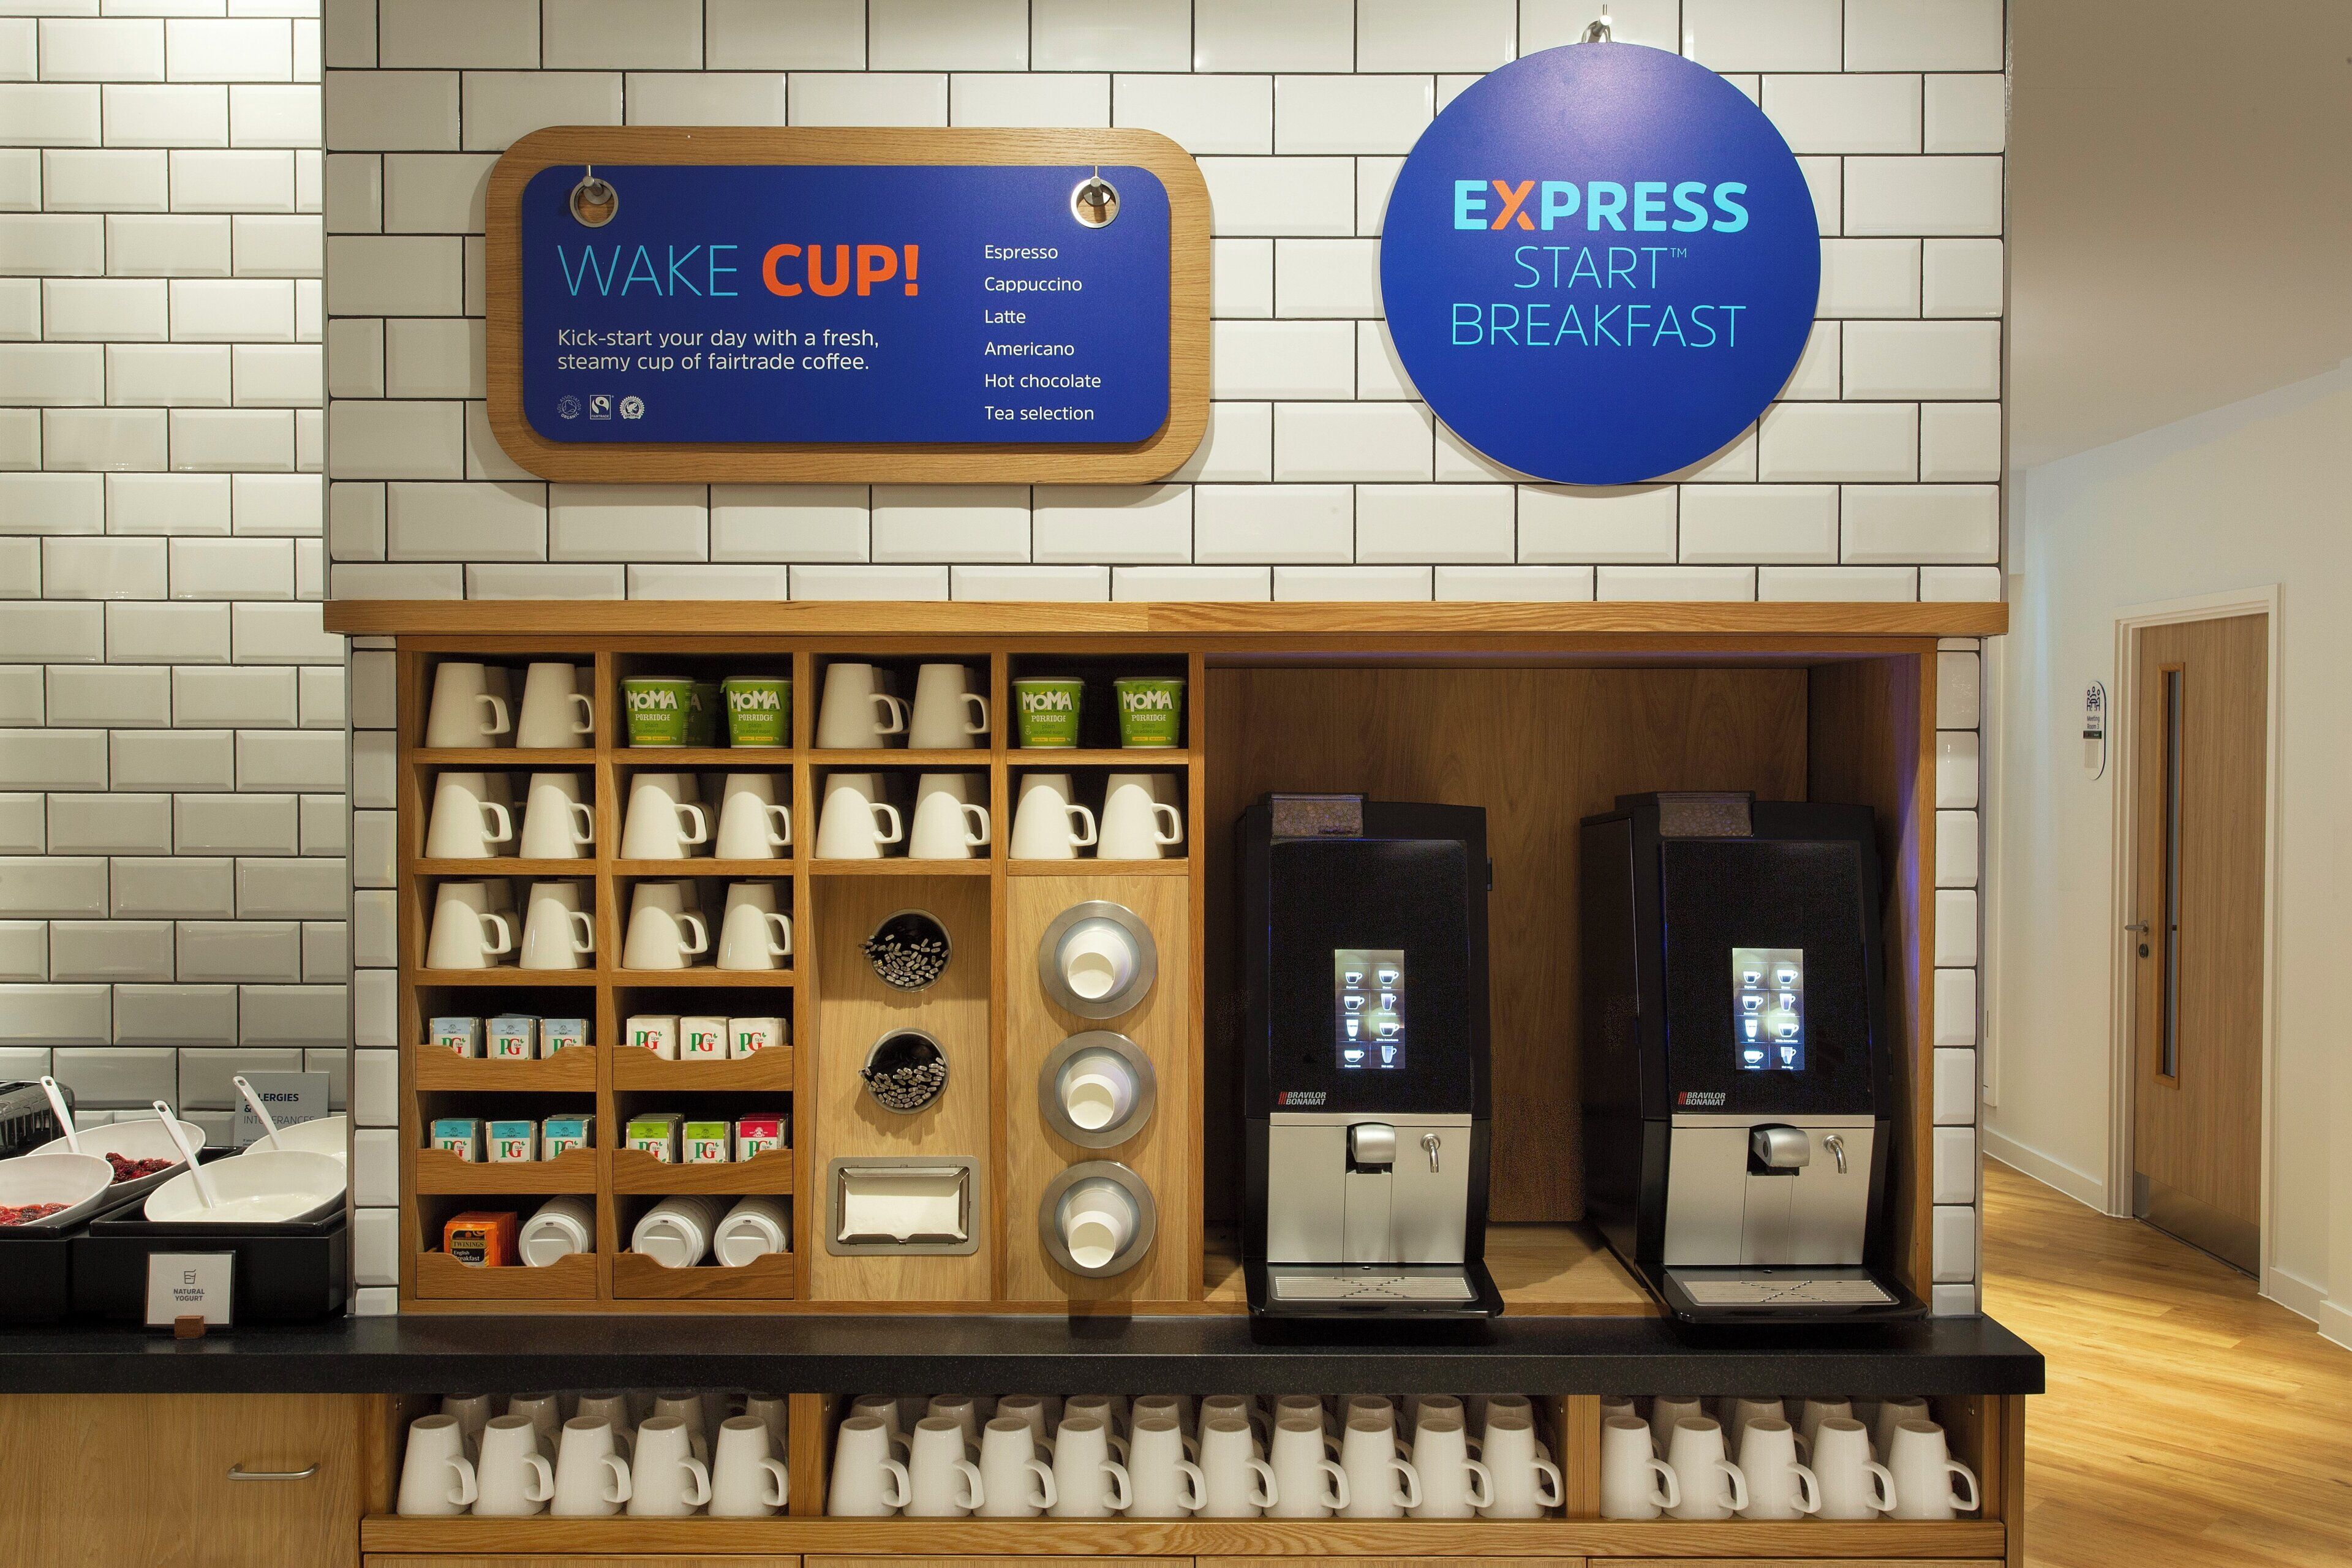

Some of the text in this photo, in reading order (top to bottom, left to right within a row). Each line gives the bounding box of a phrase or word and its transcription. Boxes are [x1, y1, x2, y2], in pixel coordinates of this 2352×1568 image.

[1455, 180, 1749, 233] EXPRESS
[985, 245, 1058, 261] Espresso
[557, 244, 919, 296] WAKE CUP!
[985, 277, 1082, 293] Cappuccino
[985, 309, 1026, 324] Latte
[1452, 303, 1746, 347] BREAKFAST
[559, 329, 879, 349] Kick-start your day with a fresh,
[985, 341, 1075, 356] Americano
[558, 352, 870, 372] steamy cup of fairtrade coffee.
[985, 373, 1101, 388] Hot chocolate
[560, 394, 581, 411] ASSOCIATION
[560, 411, 579, 420] ORGANIC
[984, 405, 1094, 420] Tea selection
[628, 690, 677, 712] MOMA
[730, 690, 781, 712] MOMA
[1022, 691, 1072, 713] MOMA
[1122, 690, 1173, 712] MOMA
[500, 1038, 521, 1055] PG
[635, 1031, 658, 1050] PG
[690, 1033, 714, 1052] PG
[739, 1032, 763, 1052] PG
[244, 1093, 300, 1102] LERGIES
[500, 1141, 522, 1158] PG
[695, 1142, 715, 1159] PG
